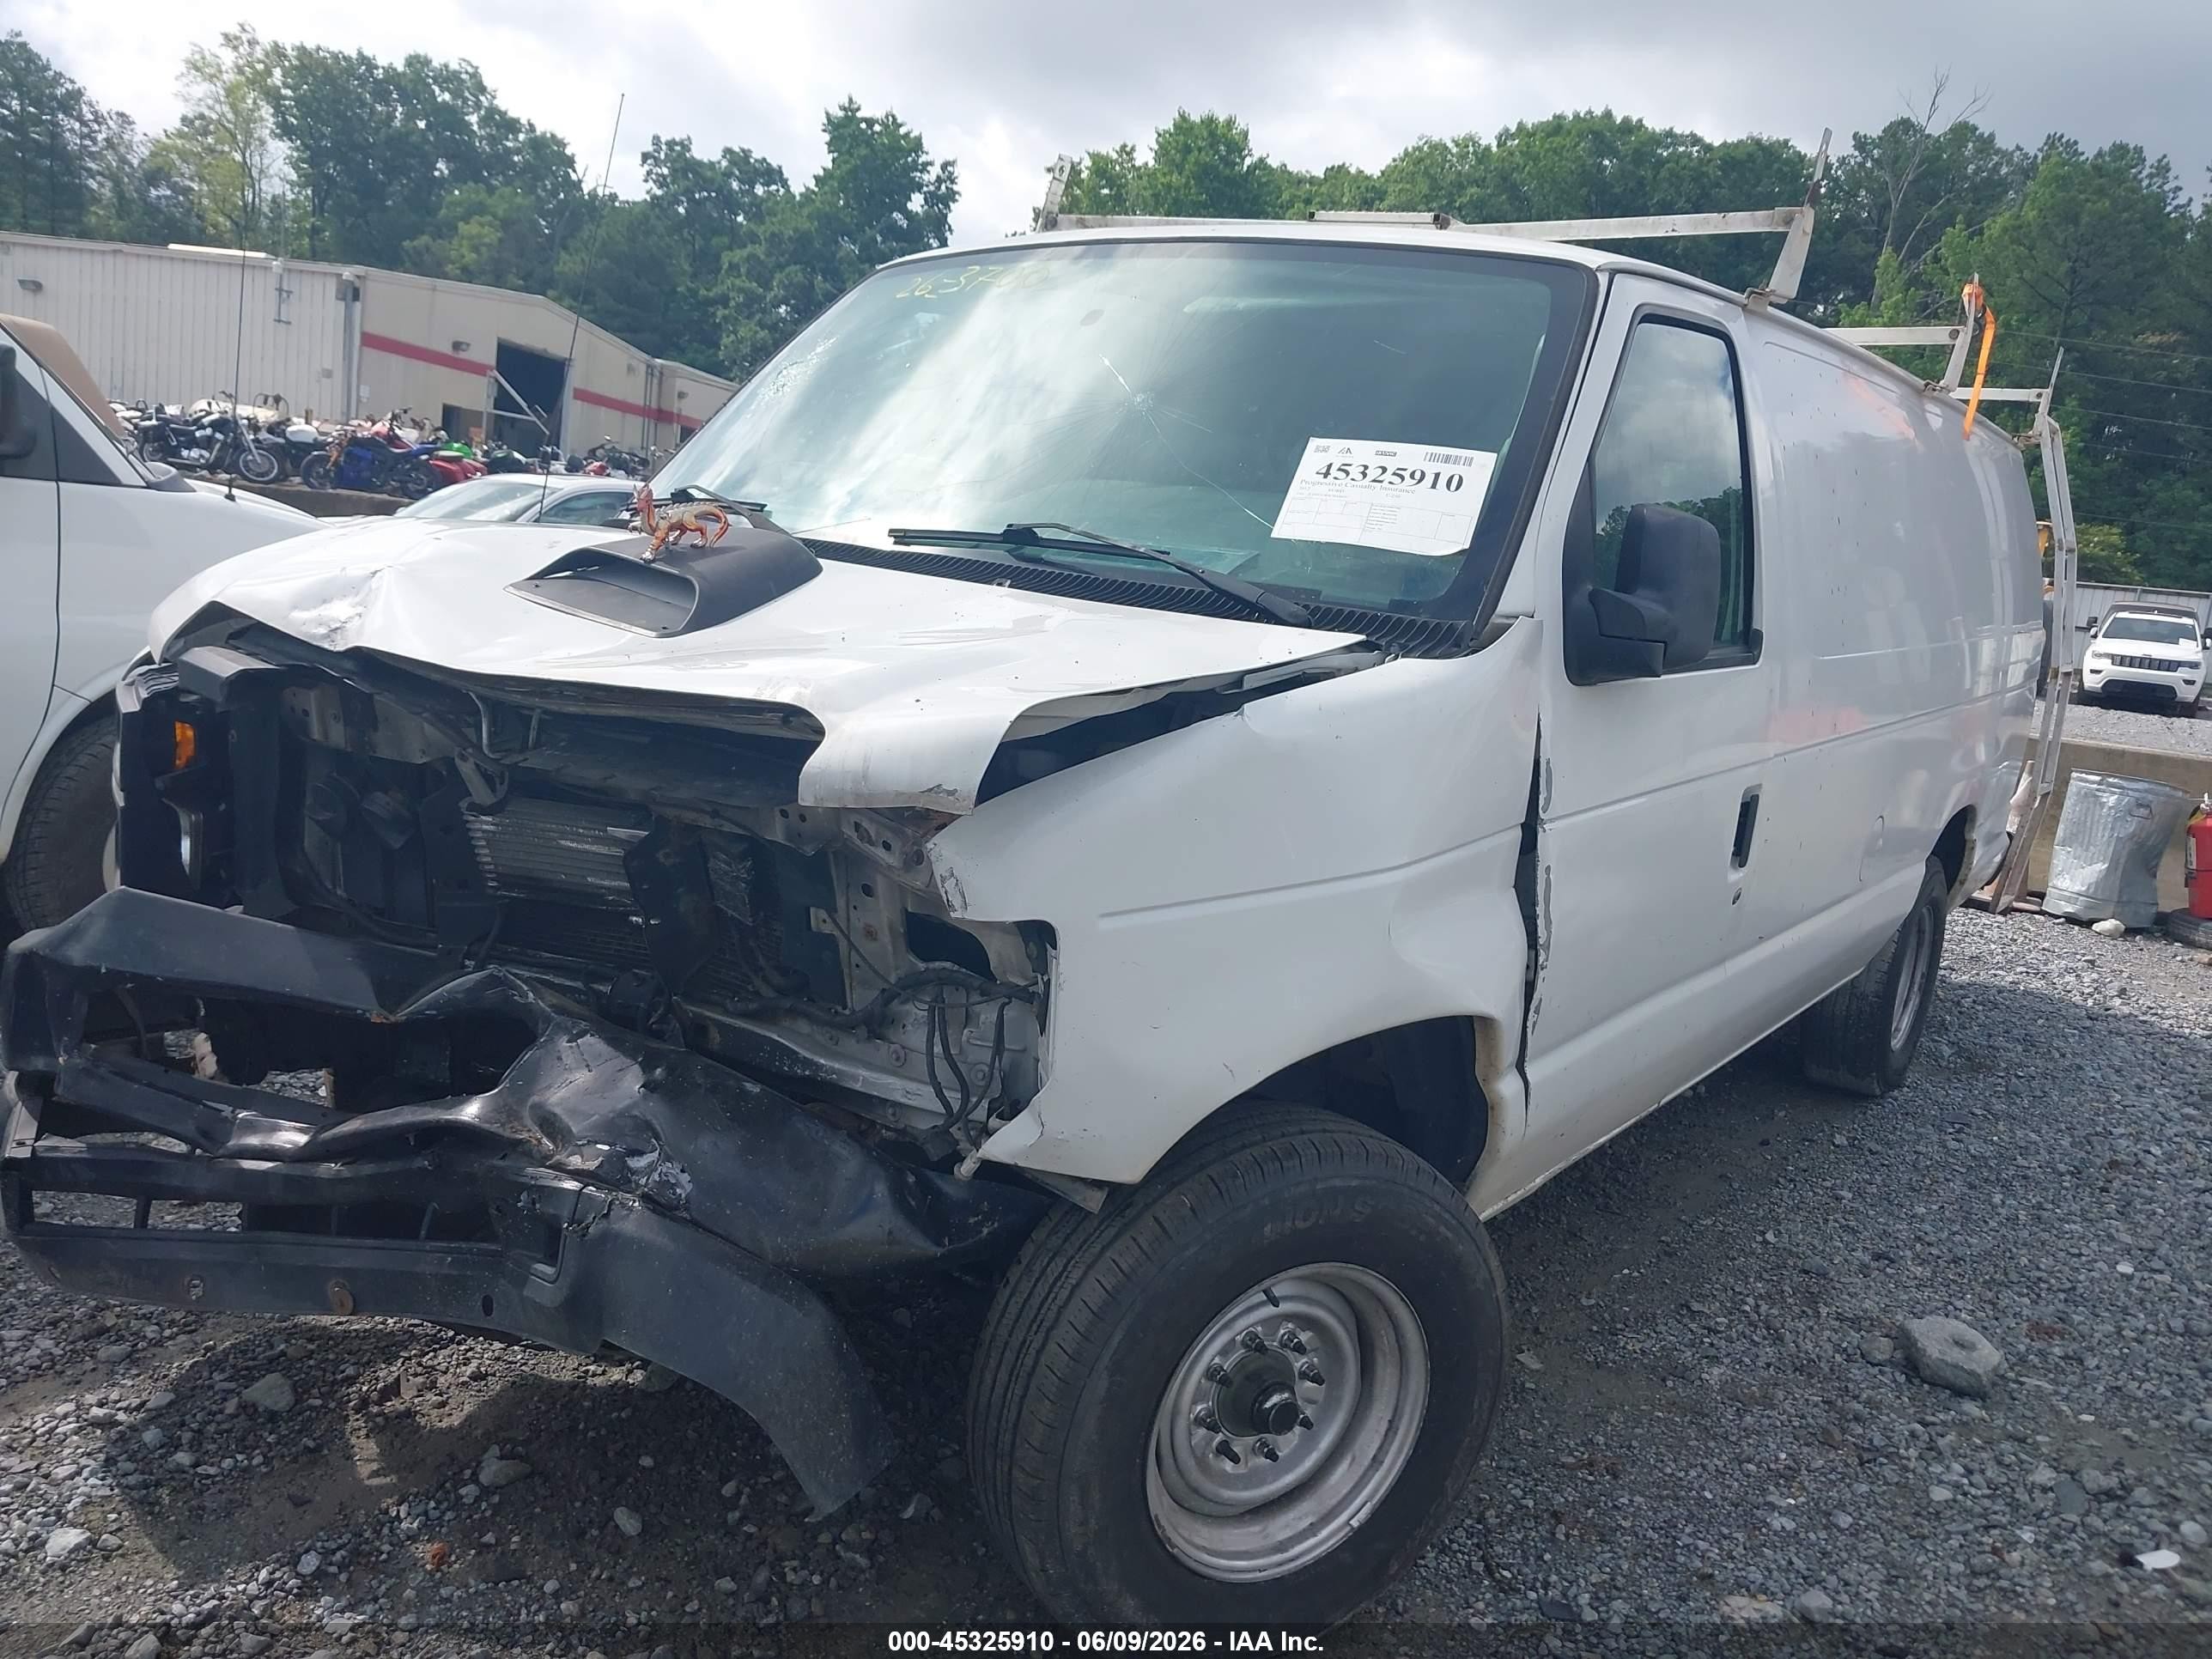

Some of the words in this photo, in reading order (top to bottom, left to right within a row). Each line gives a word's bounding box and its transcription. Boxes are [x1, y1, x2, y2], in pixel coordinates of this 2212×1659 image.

[1299, 478, 1343, 488] Progressive
[1344, 480, 1377, 491] Casualty
[1379, 484, 1417, 495] Insurance
[1315, 461, 1464, 493] 45325910
